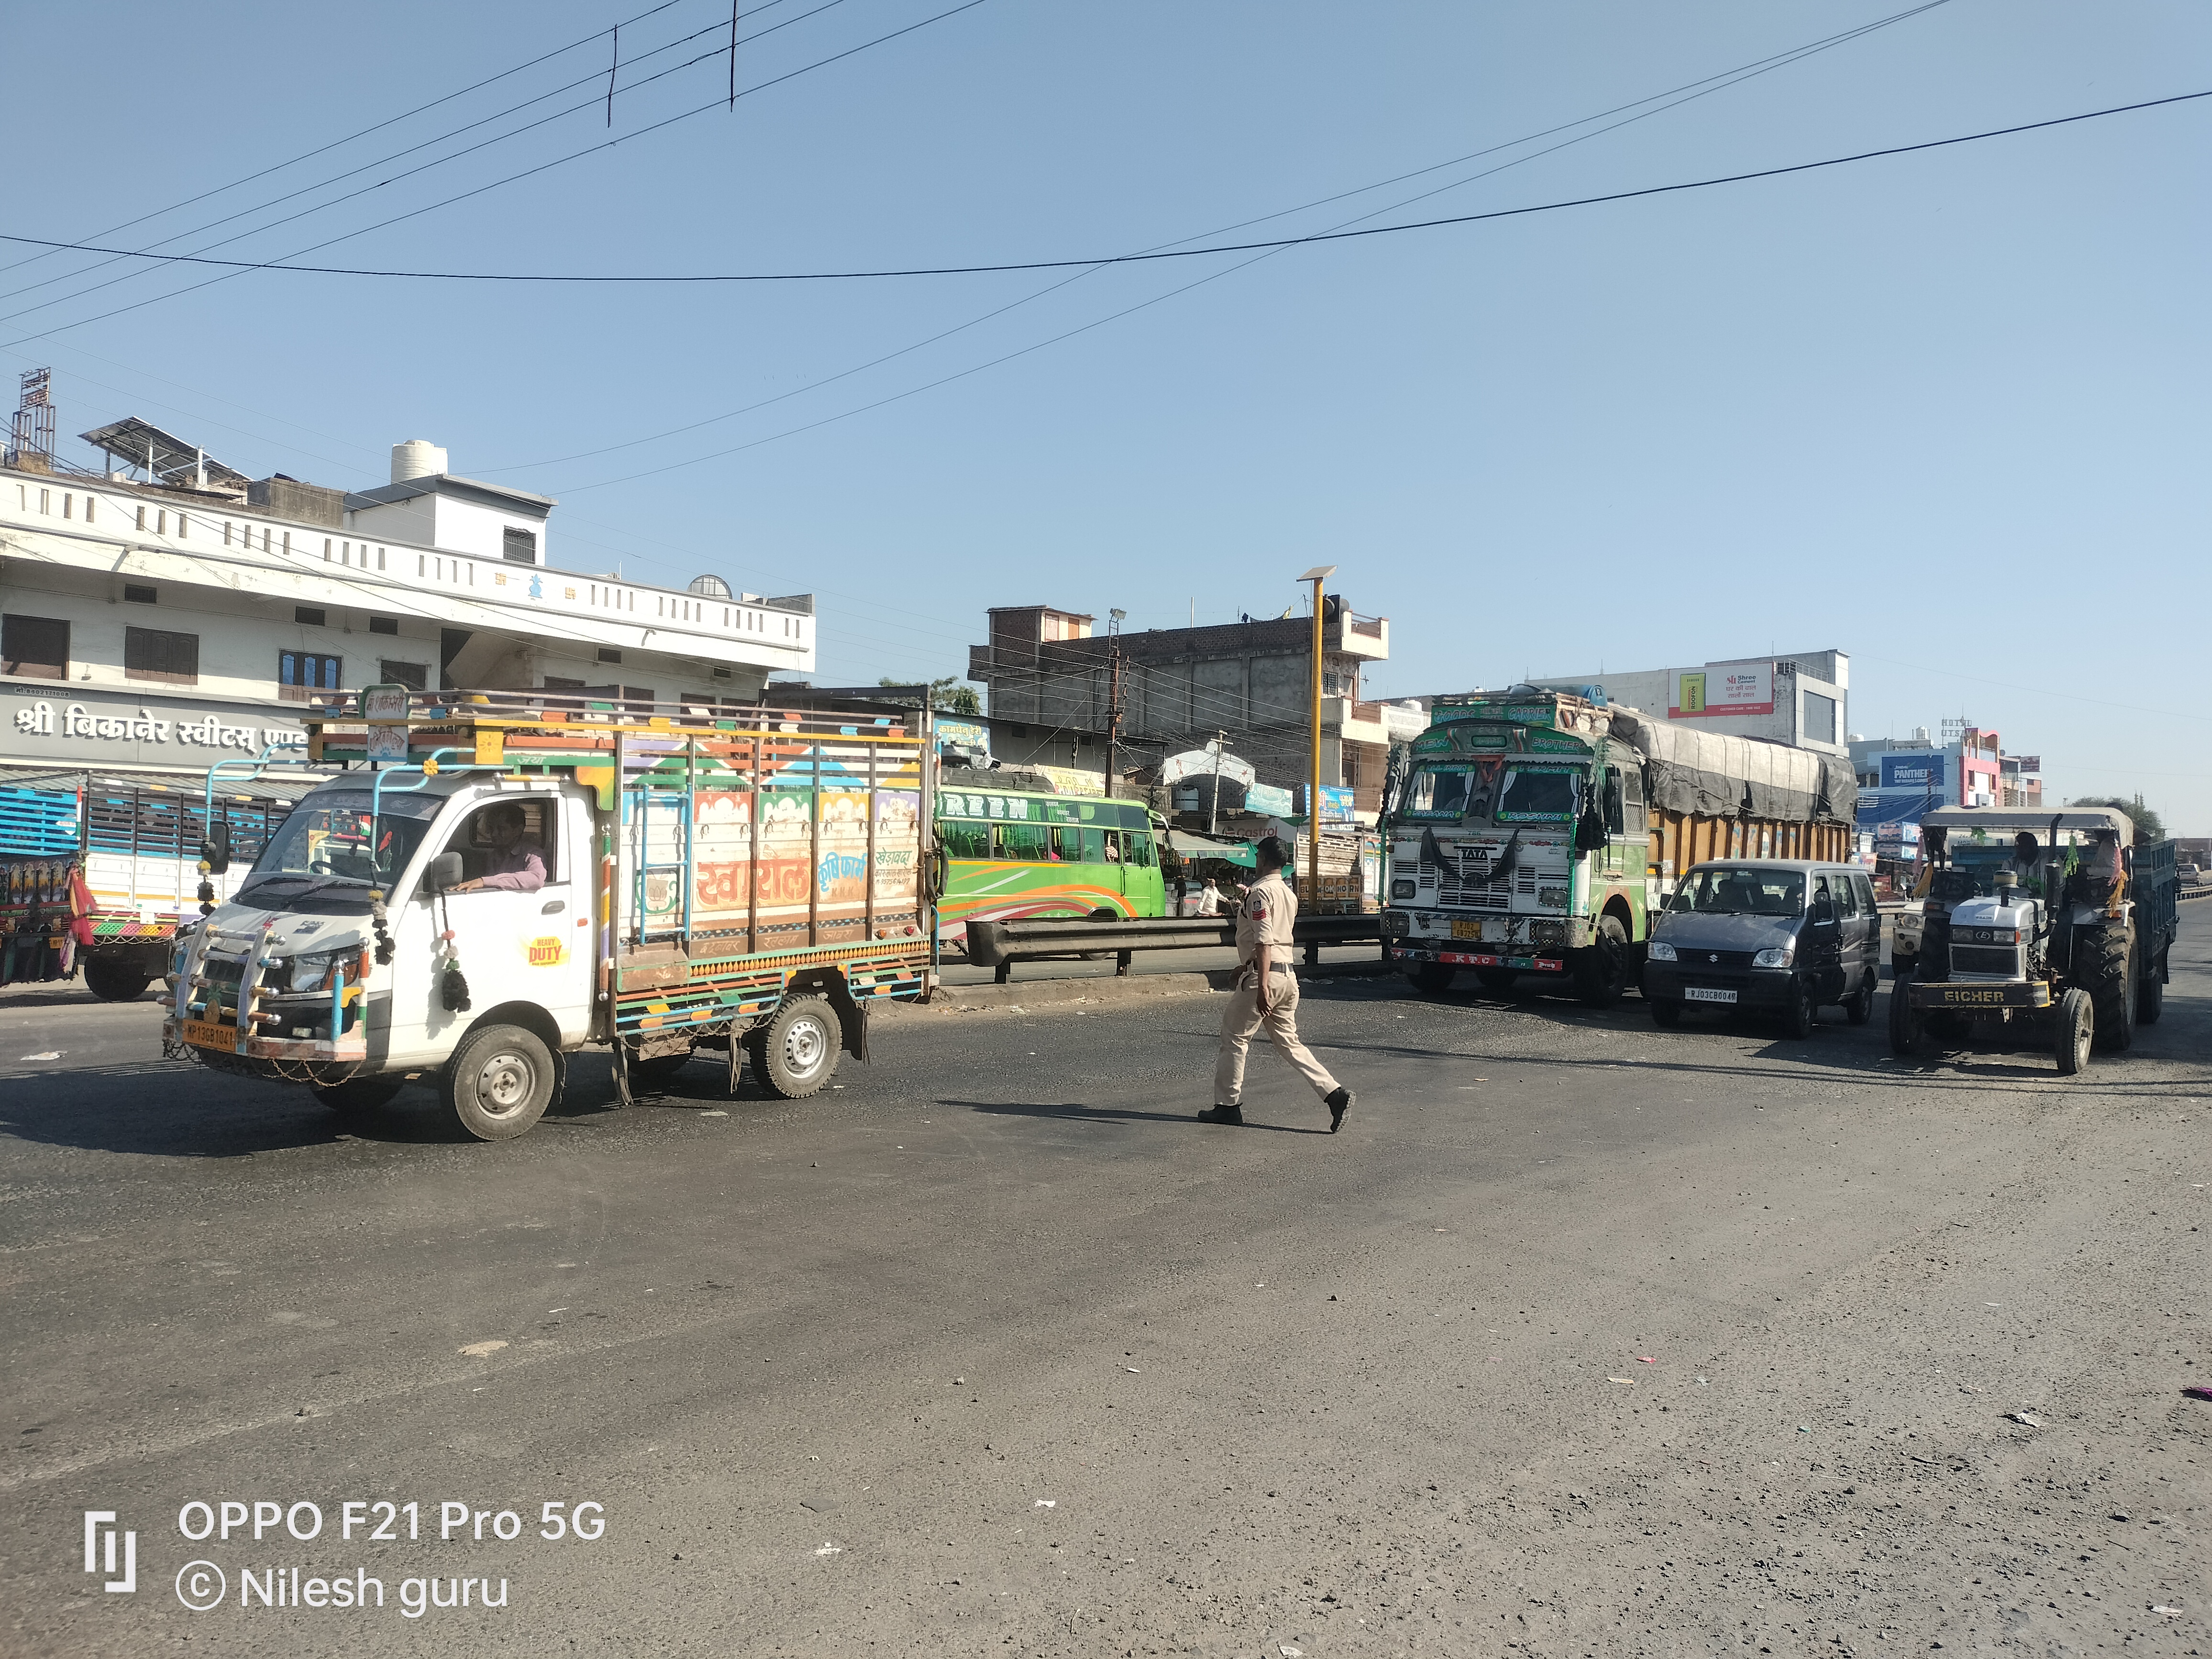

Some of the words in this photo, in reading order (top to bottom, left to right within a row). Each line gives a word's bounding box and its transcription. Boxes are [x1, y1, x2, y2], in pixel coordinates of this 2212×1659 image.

[17, 701, 56, 734] श्री
[63, 703, 171, 741] बिकानेर
[1435, 709, 1475, 723] GOODS
[1508, 708, 1551, 721] CARRIER
[938, 723, 969, 737] कामधेनु
[969, 724, 982, 735] डेरी
[939, 792, 1028, 819] REEN
[1508, 812, 1562, 821] ROSHNI
[1237, 826, 1278, 838] Castrol
[1461, 849, 1488, 859] TATA
[818, 852, 840, 892] कृषि
[840, 853, 868, 882] फार्म
[537, 939, 555, 947] HEAVY
[529, 944, 562, 963] DUTY
[1944, 991, 2004, 1002] EICHER
